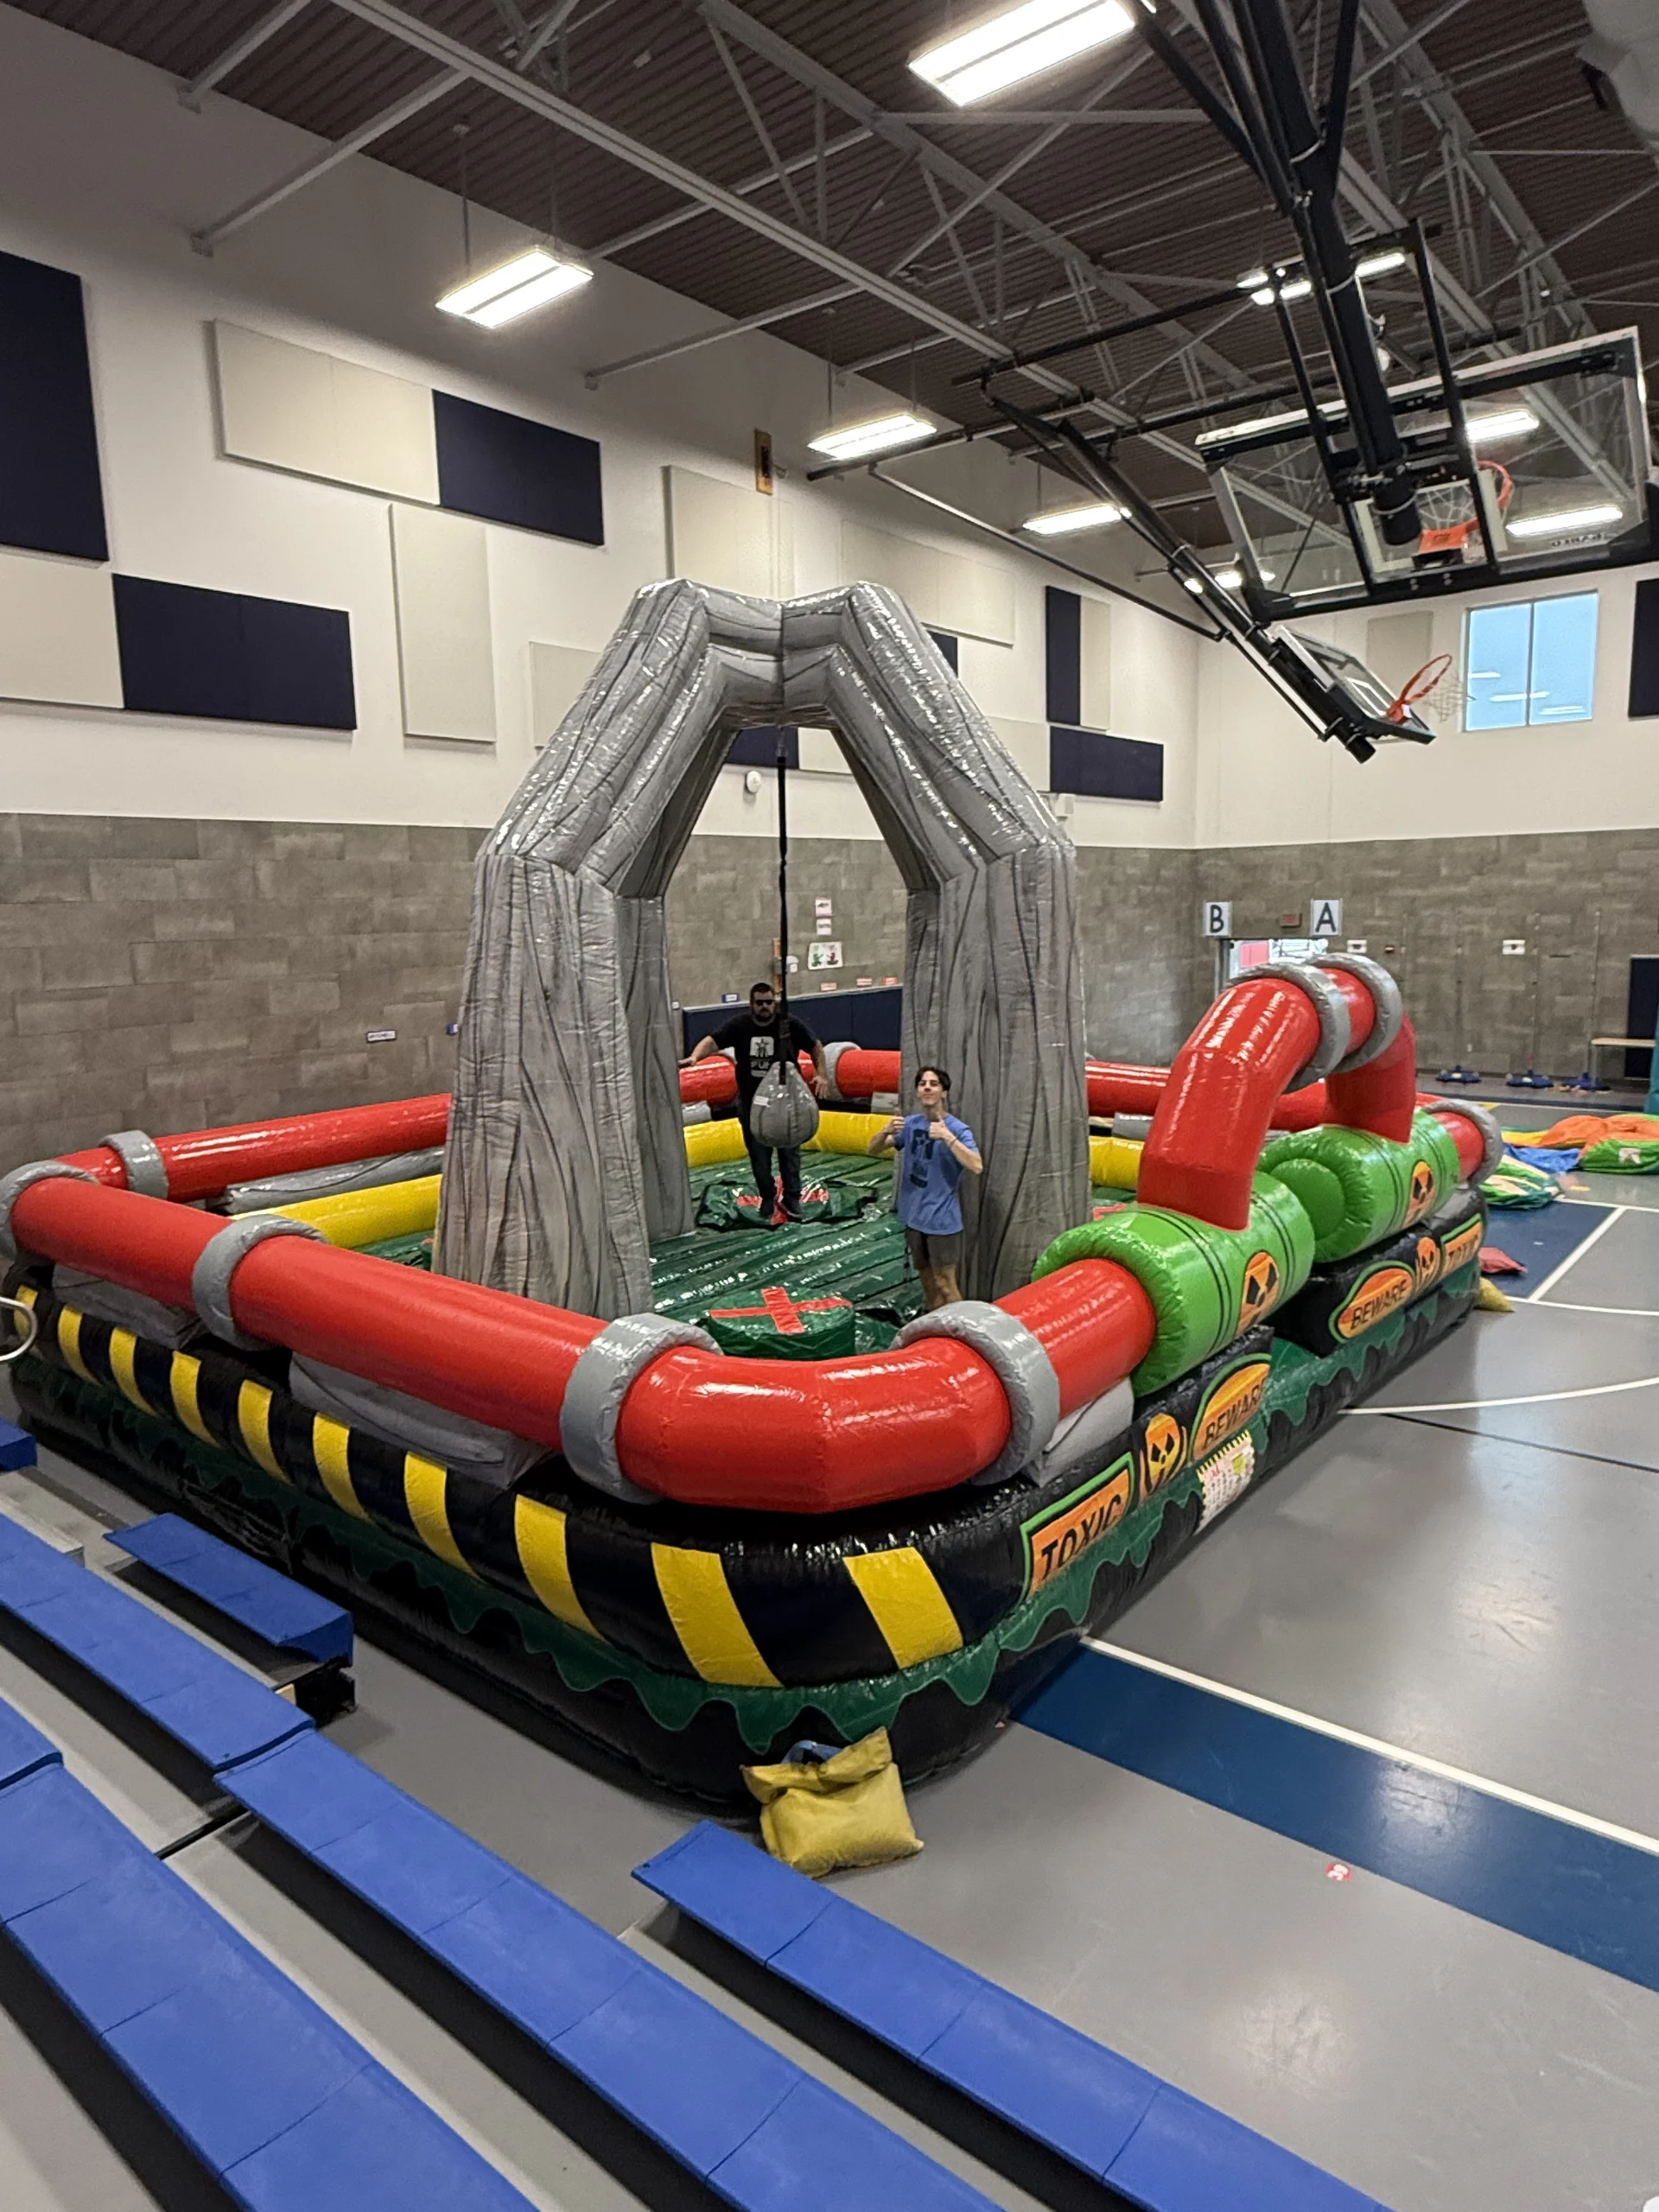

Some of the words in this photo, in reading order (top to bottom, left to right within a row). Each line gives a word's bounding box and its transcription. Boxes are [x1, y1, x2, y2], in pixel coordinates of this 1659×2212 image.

[1211, 905, 1224, 933] B
[1315, 902, 1336, 932] A
[1350, 1280, 1408, 1330] BEWARE
[1041, 1494, 1122, 1581] TOXIC
